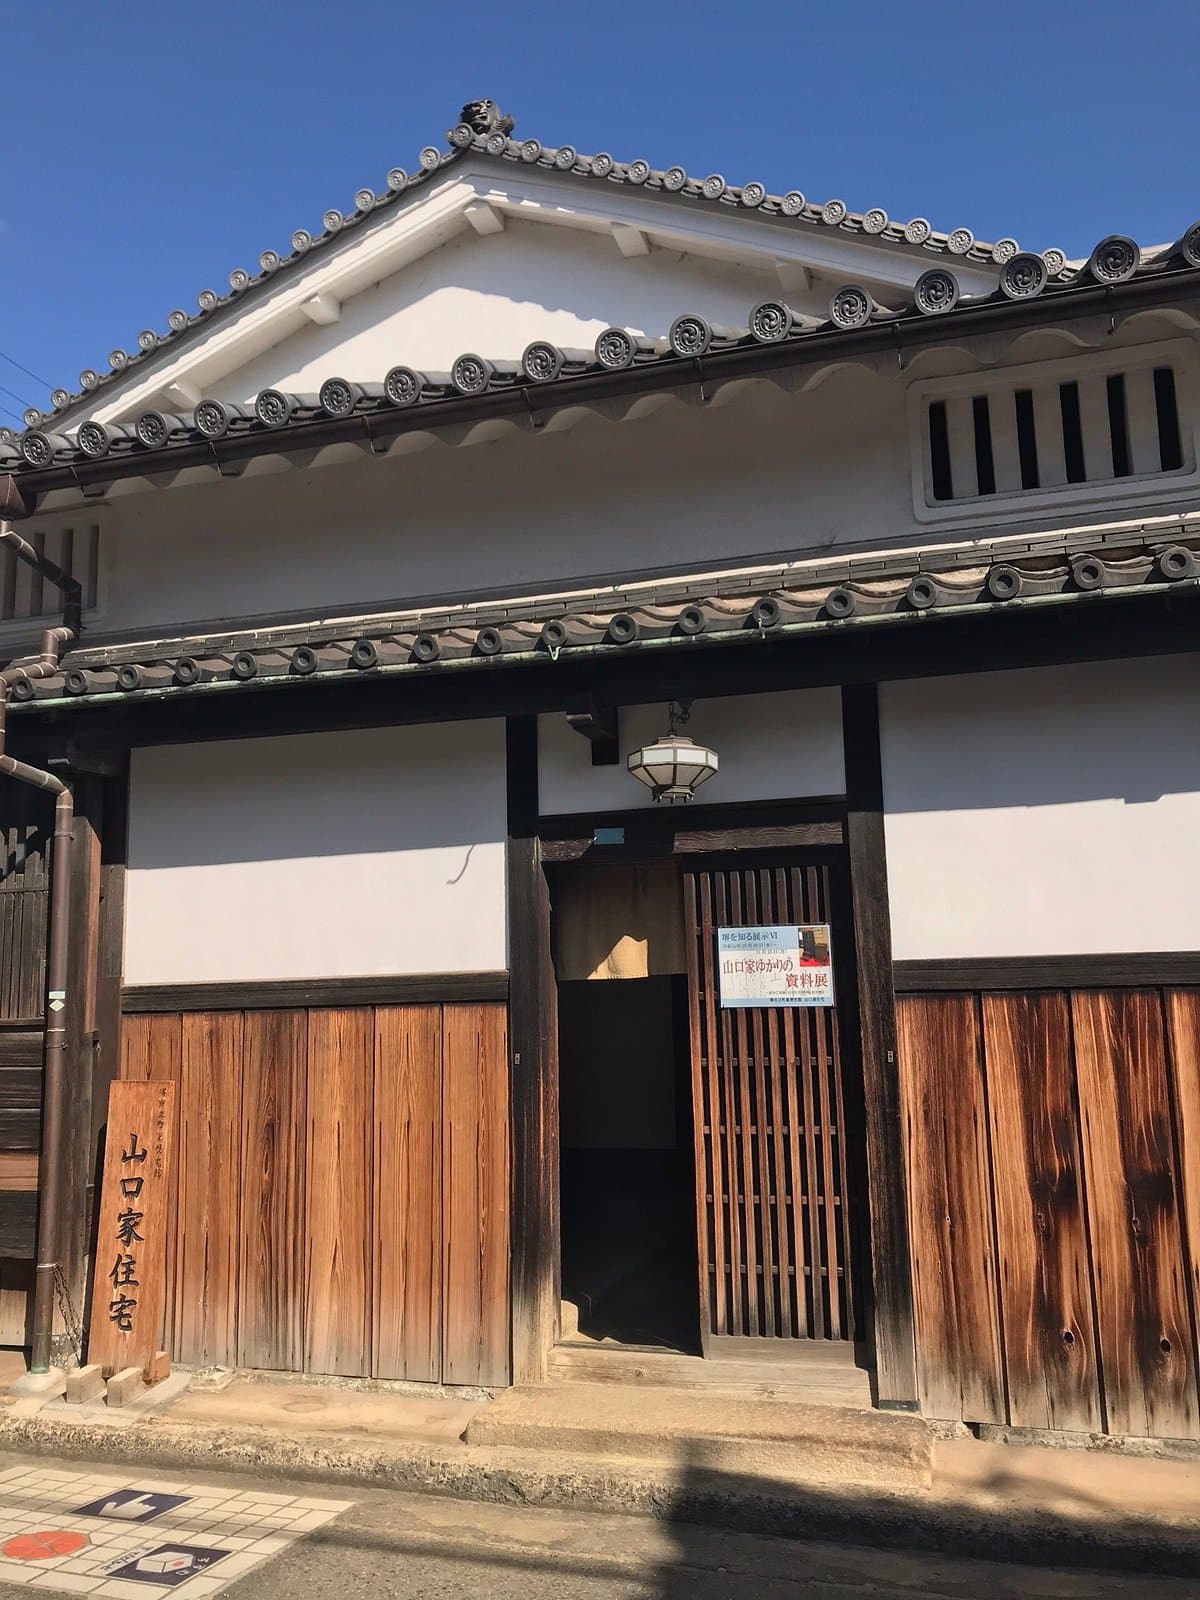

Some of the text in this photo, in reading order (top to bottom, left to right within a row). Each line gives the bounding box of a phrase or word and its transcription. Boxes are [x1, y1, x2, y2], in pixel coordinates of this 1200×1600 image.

[723, 959, 794, 975] 山口家ゆかりの
[785, 973, 829, 988] 資料展
[109, 1133, 148, 1332] 山口家住宅
